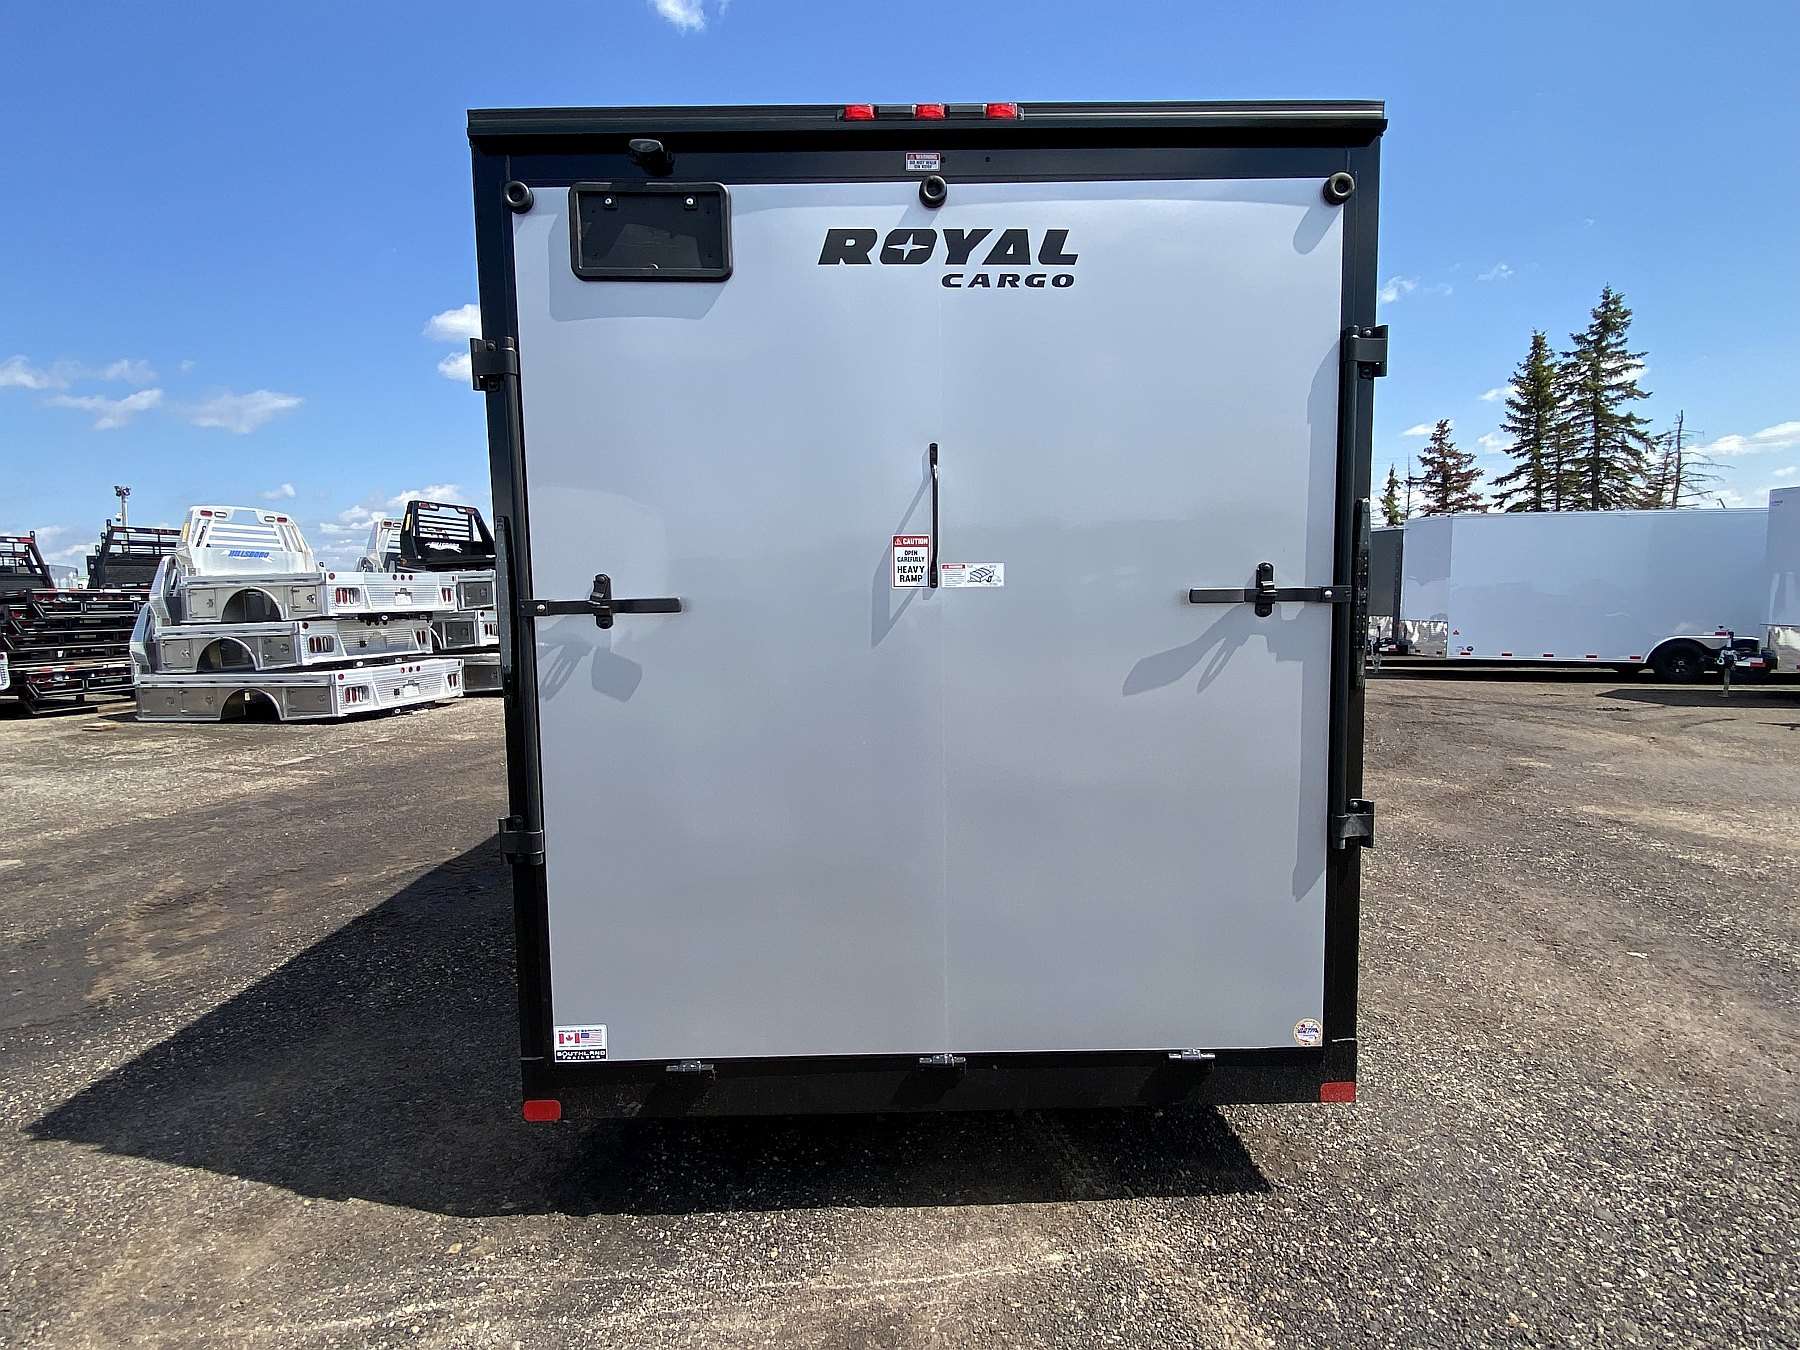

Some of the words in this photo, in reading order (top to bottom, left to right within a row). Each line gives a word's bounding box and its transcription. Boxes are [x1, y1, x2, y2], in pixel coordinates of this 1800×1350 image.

[817, 228, 1079, 265] ROYAL
[941, 273, 1075, 288] CARGO
[902, 537, 928, 545] CAUTION
[228, 549, 270, 558] HILLSBORO
[897, 565, 925, 574] HEAVY
[899, 574, 923, 583] RAMP
